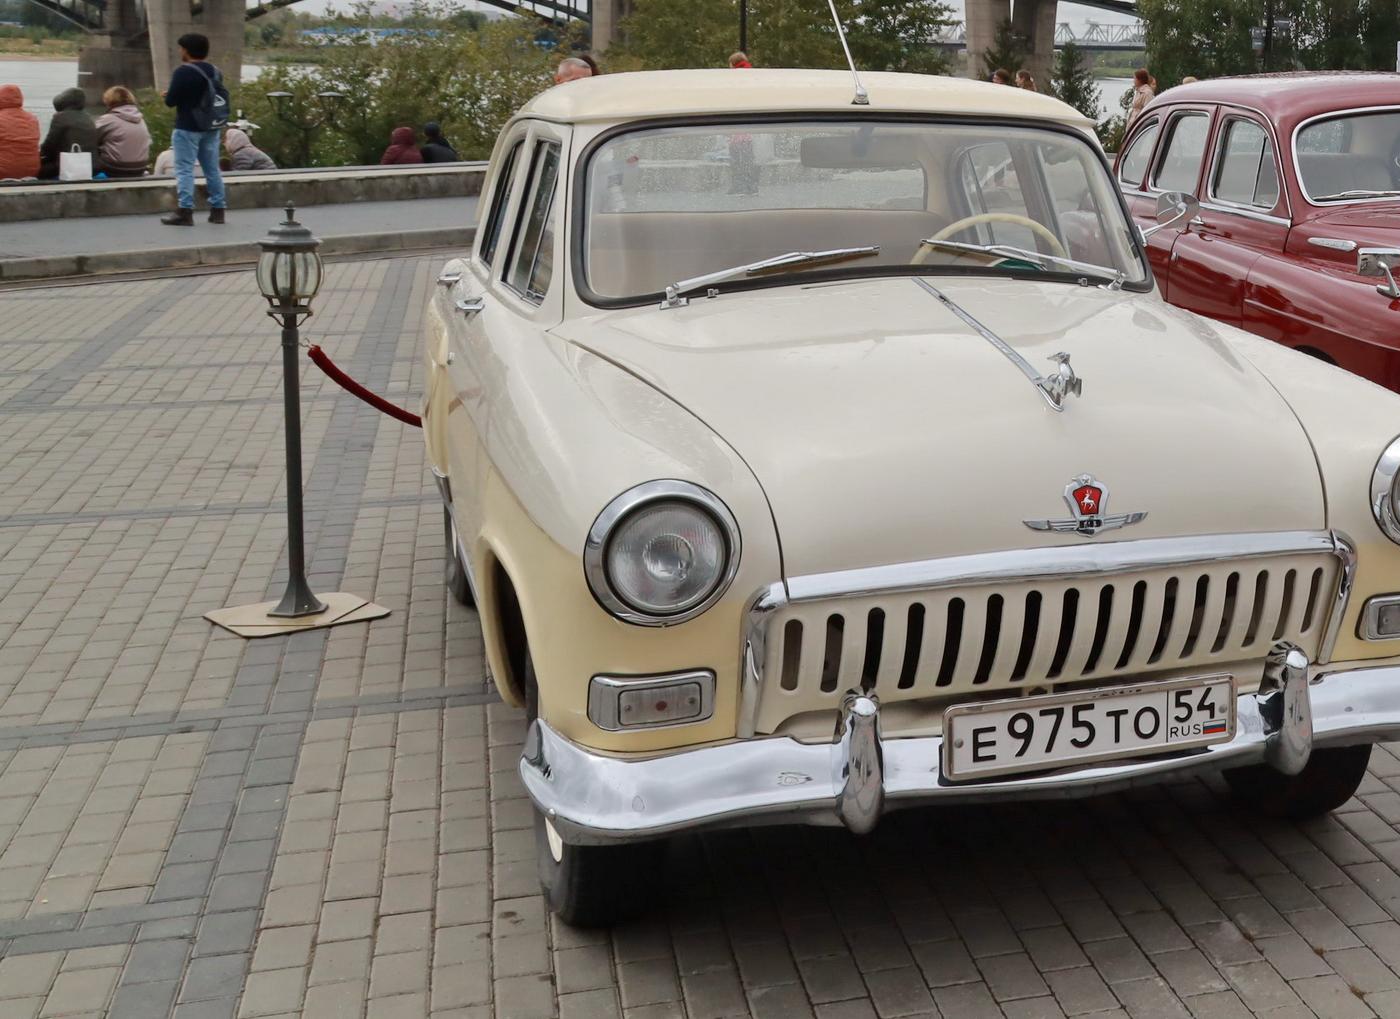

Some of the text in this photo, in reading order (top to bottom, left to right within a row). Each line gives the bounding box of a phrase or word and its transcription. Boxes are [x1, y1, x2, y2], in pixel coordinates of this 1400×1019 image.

[972, 687, 1216, 763] Е975ТО 54
[1170, 723, 1201, 739] RUS
